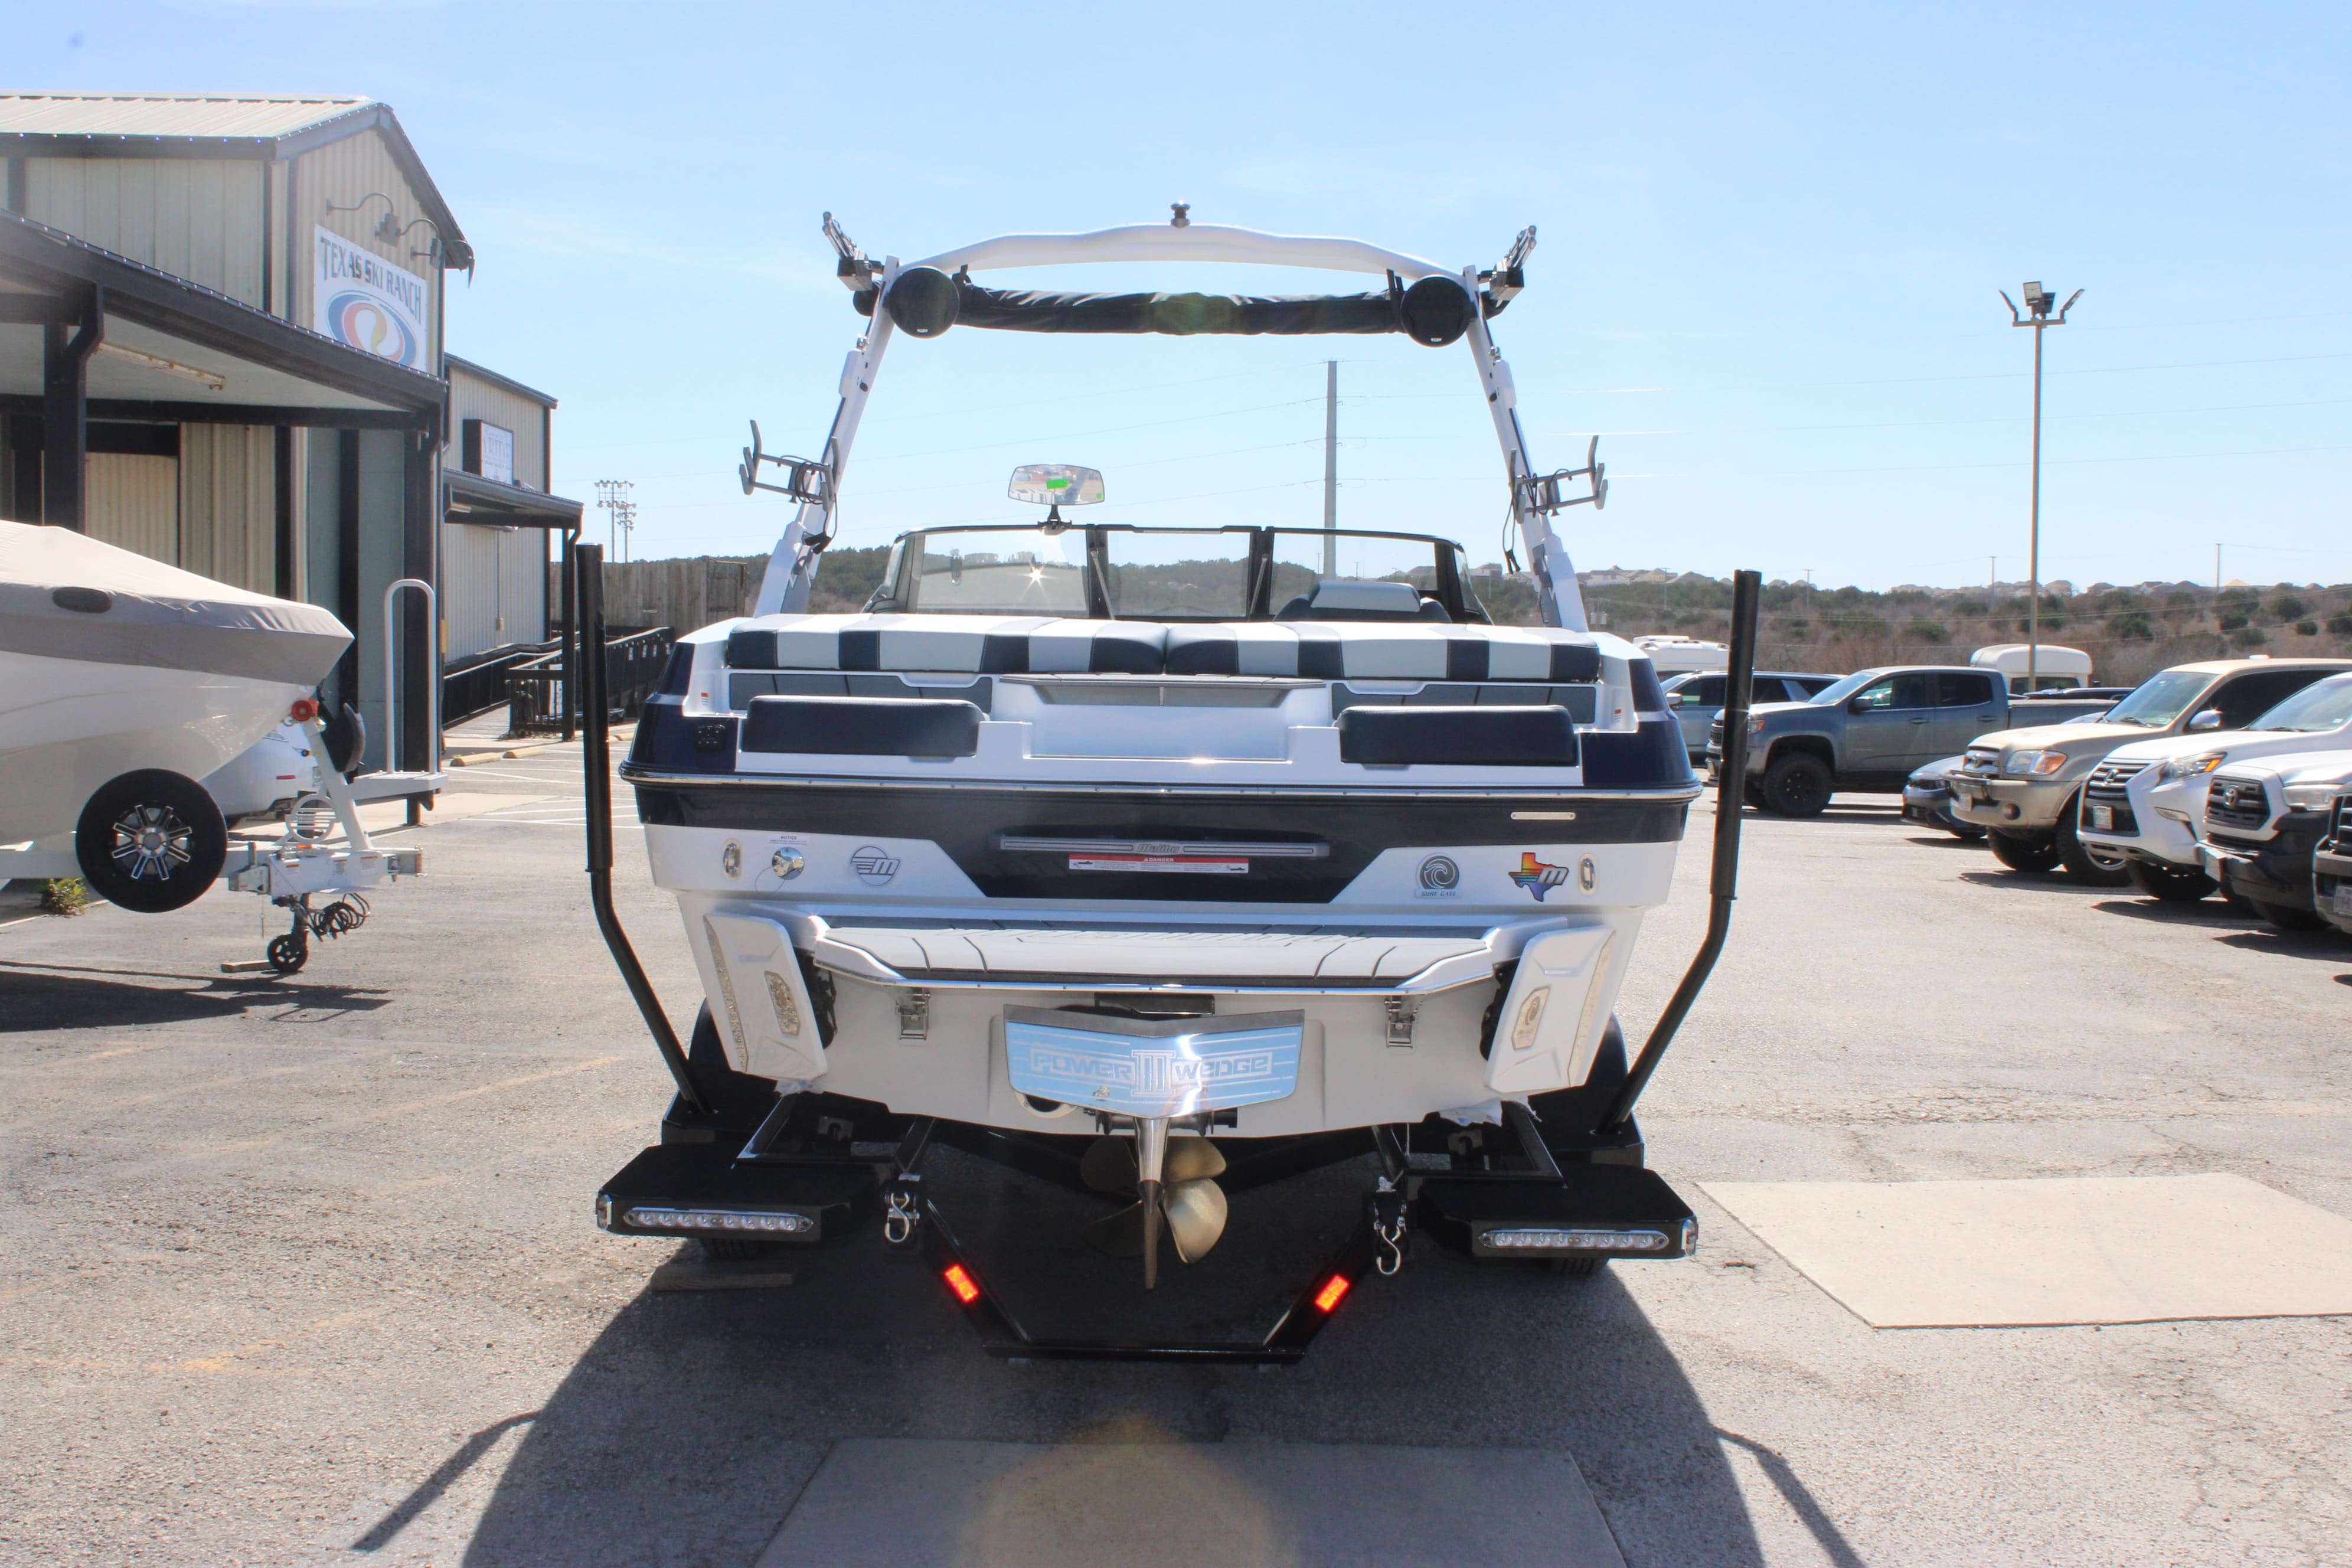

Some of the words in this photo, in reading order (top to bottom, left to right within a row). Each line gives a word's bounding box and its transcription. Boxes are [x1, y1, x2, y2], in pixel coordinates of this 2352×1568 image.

[321, 237, 362, 282] TEXAS
[364, 260, 383, 290] SKI
[387, 271, 422, 325] RANCH
[1032, 1053, 1134, 1082] POWER
[1174, 1054, 1270, 1082] WEDGE
